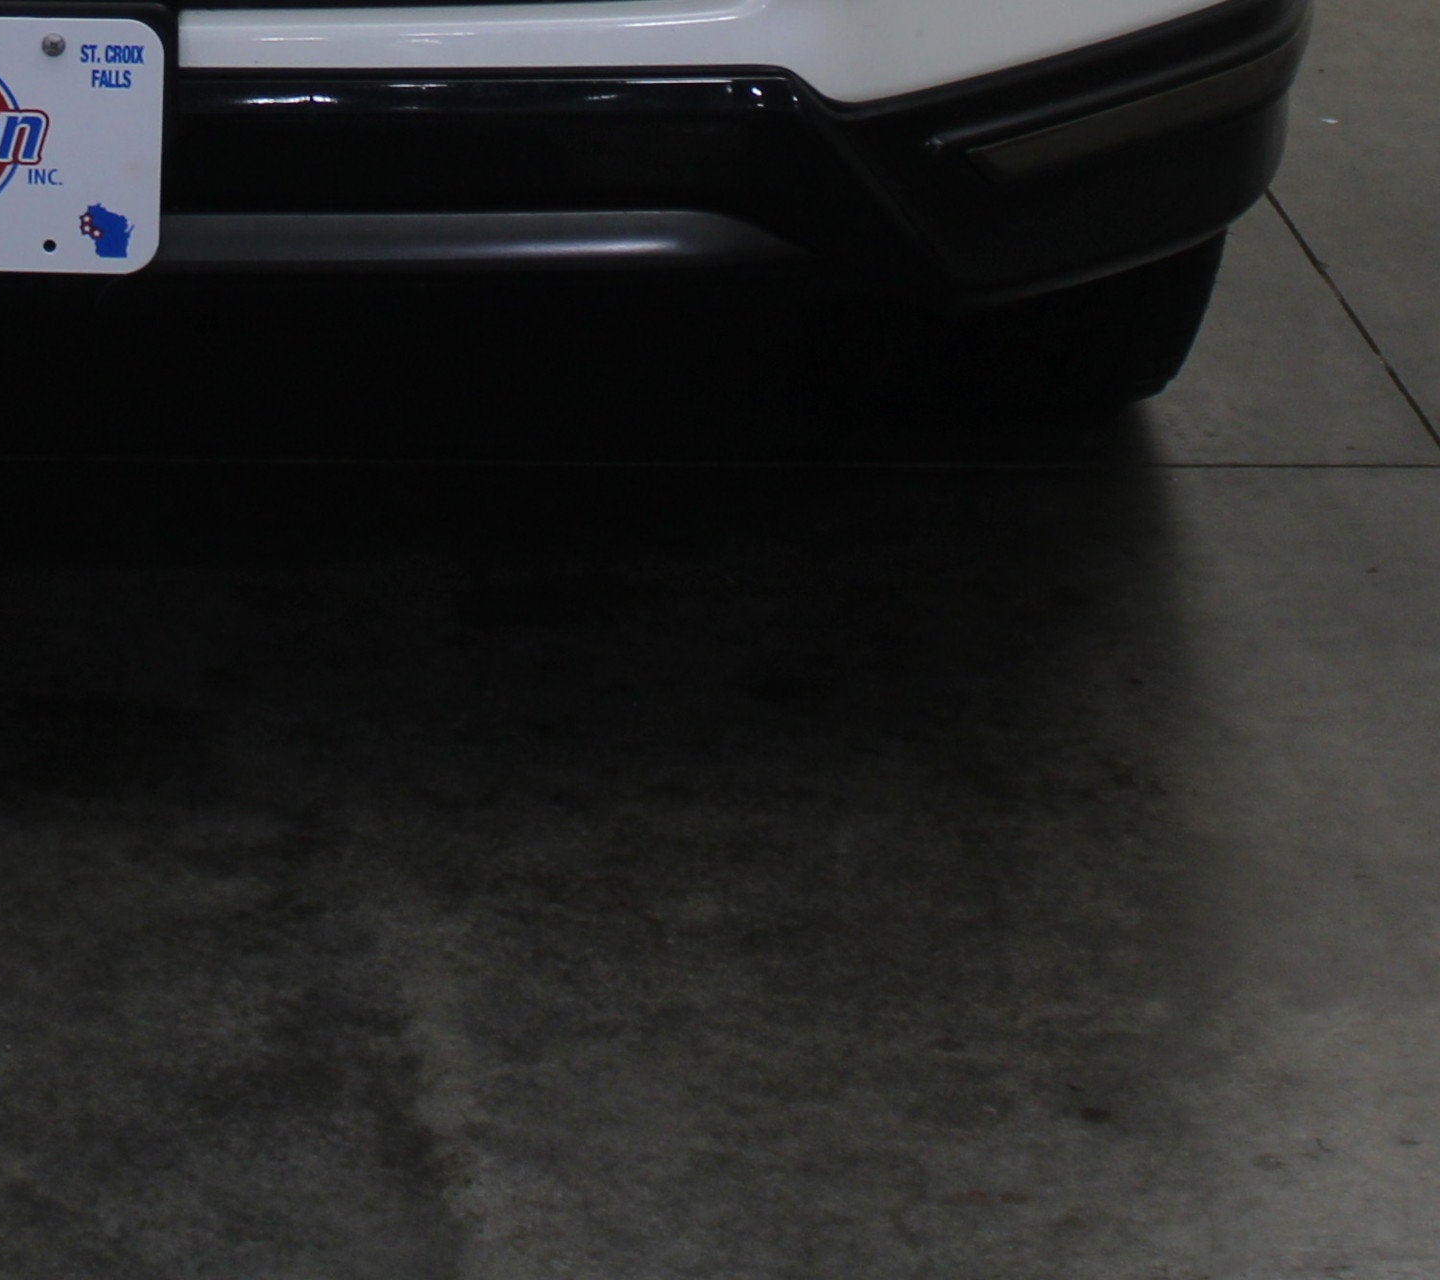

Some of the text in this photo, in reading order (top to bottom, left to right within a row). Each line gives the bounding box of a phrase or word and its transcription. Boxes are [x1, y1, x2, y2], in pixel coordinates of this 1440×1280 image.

[80, 44, 144, 64] ST. CROIX
[91, 69, 131, 88] FALLS
[28, 168, 64, 186] INC.
